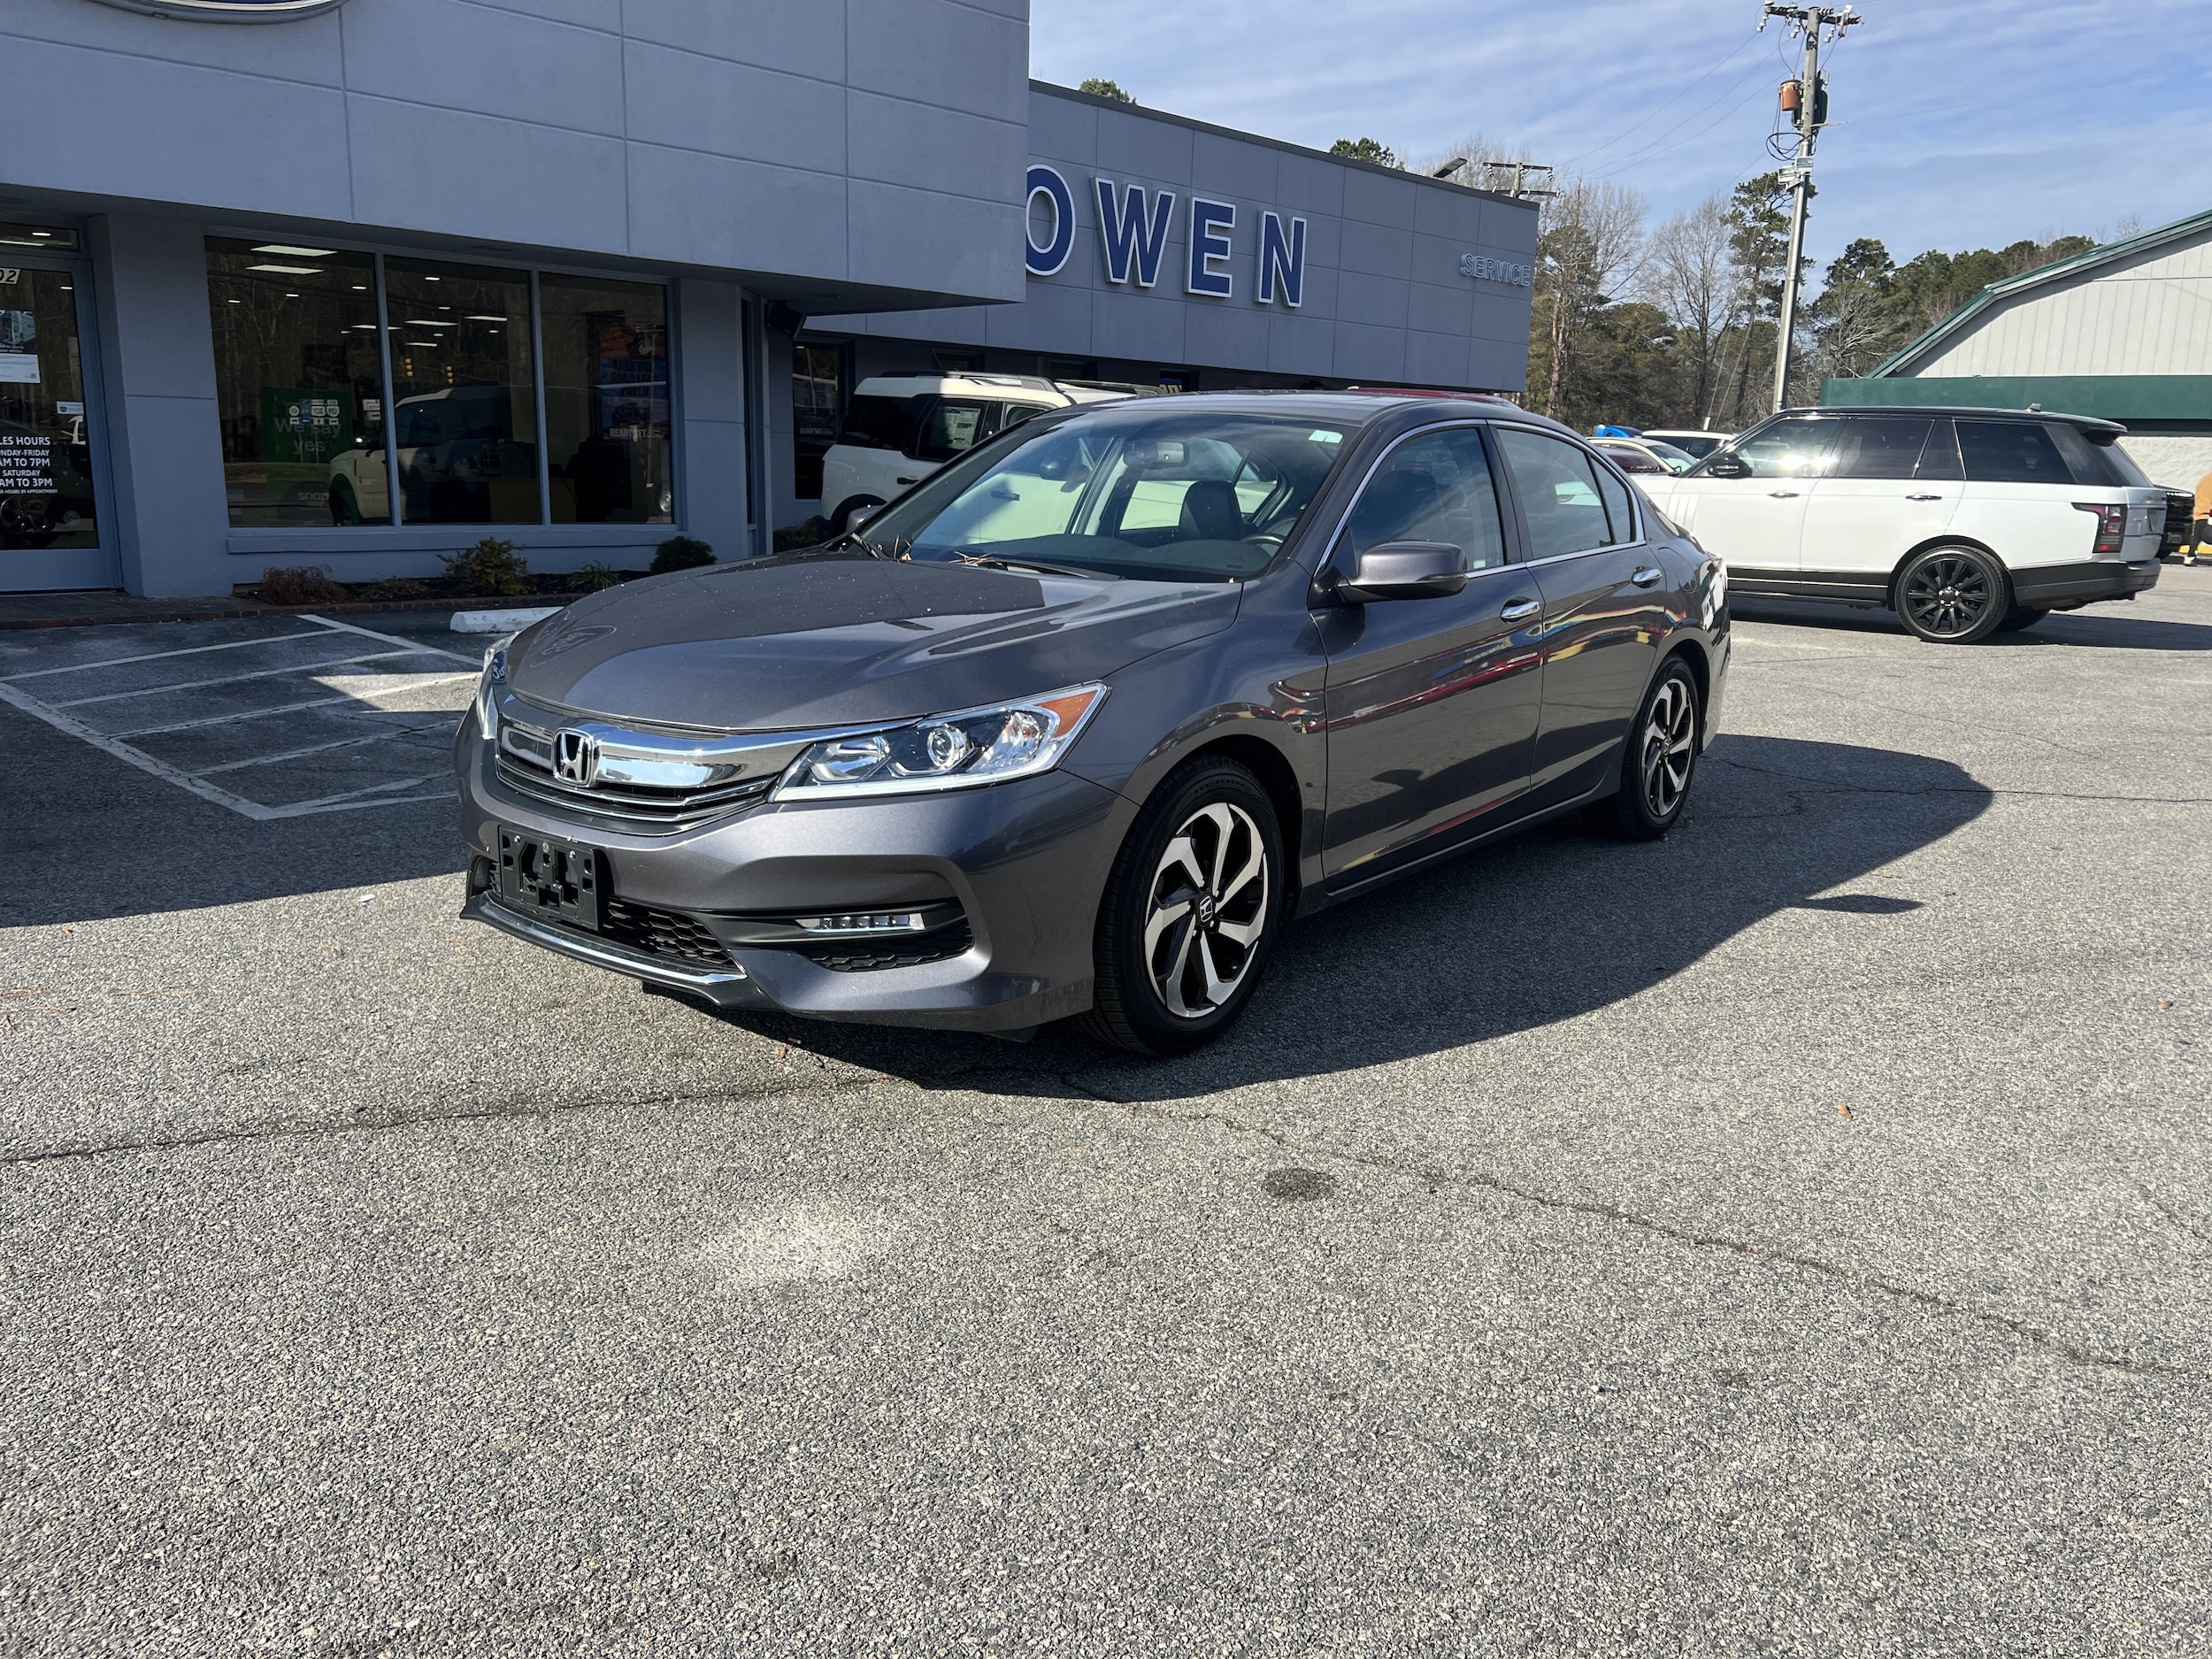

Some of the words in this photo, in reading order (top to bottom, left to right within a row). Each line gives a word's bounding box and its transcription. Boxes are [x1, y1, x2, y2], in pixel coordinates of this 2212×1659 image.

[1025, 164, 1307, 308] OWEN
[1460, 254, 1531, 286] SERVICE
[293, 439, 326, 456] yes
[13, 457, 27, 467] TO
[29, 457, 50, 467] 7PM
[16, 478, 30, 488] TO
[32, 478, 53, 488] 3PM
[297, 491, 330, 503] snap
